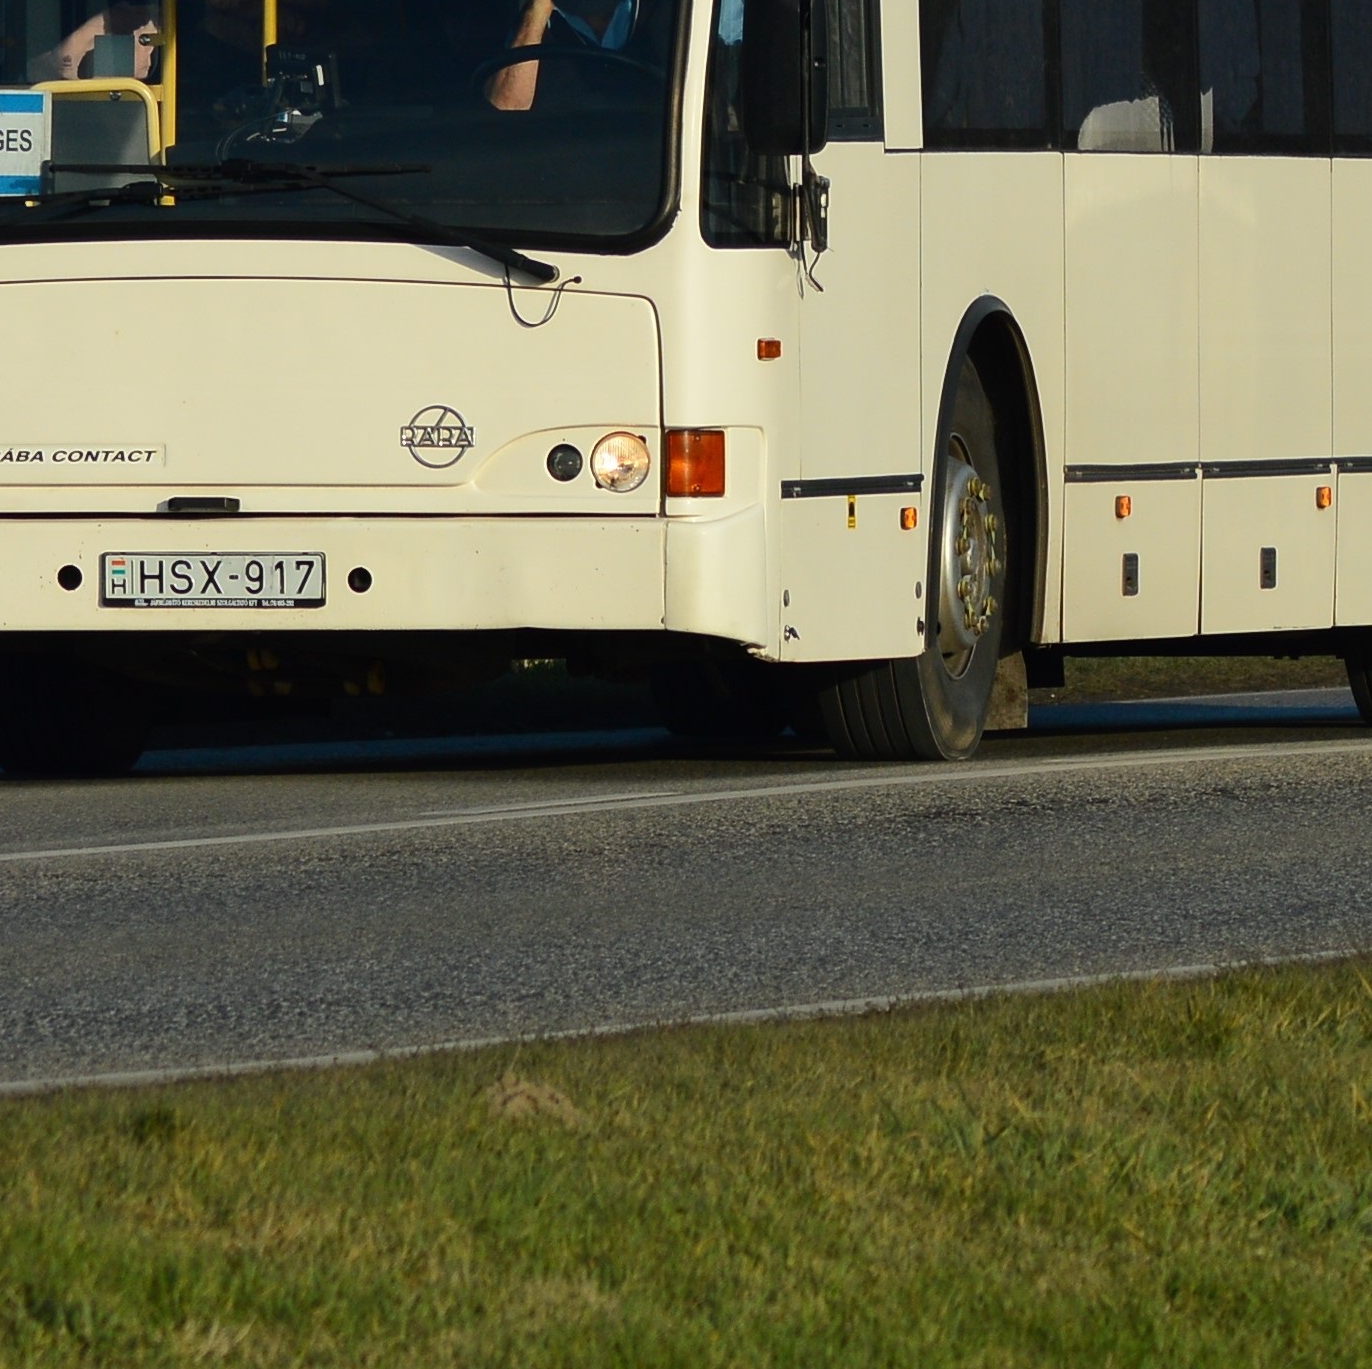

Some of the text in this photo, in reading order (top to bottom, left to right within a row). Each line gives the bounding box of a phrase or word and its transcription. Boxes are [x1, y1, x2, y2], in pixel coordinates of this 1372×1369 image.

[52, 450, 158, 463] CONTACT
[111, 560, 315, 595] H HSX-917
